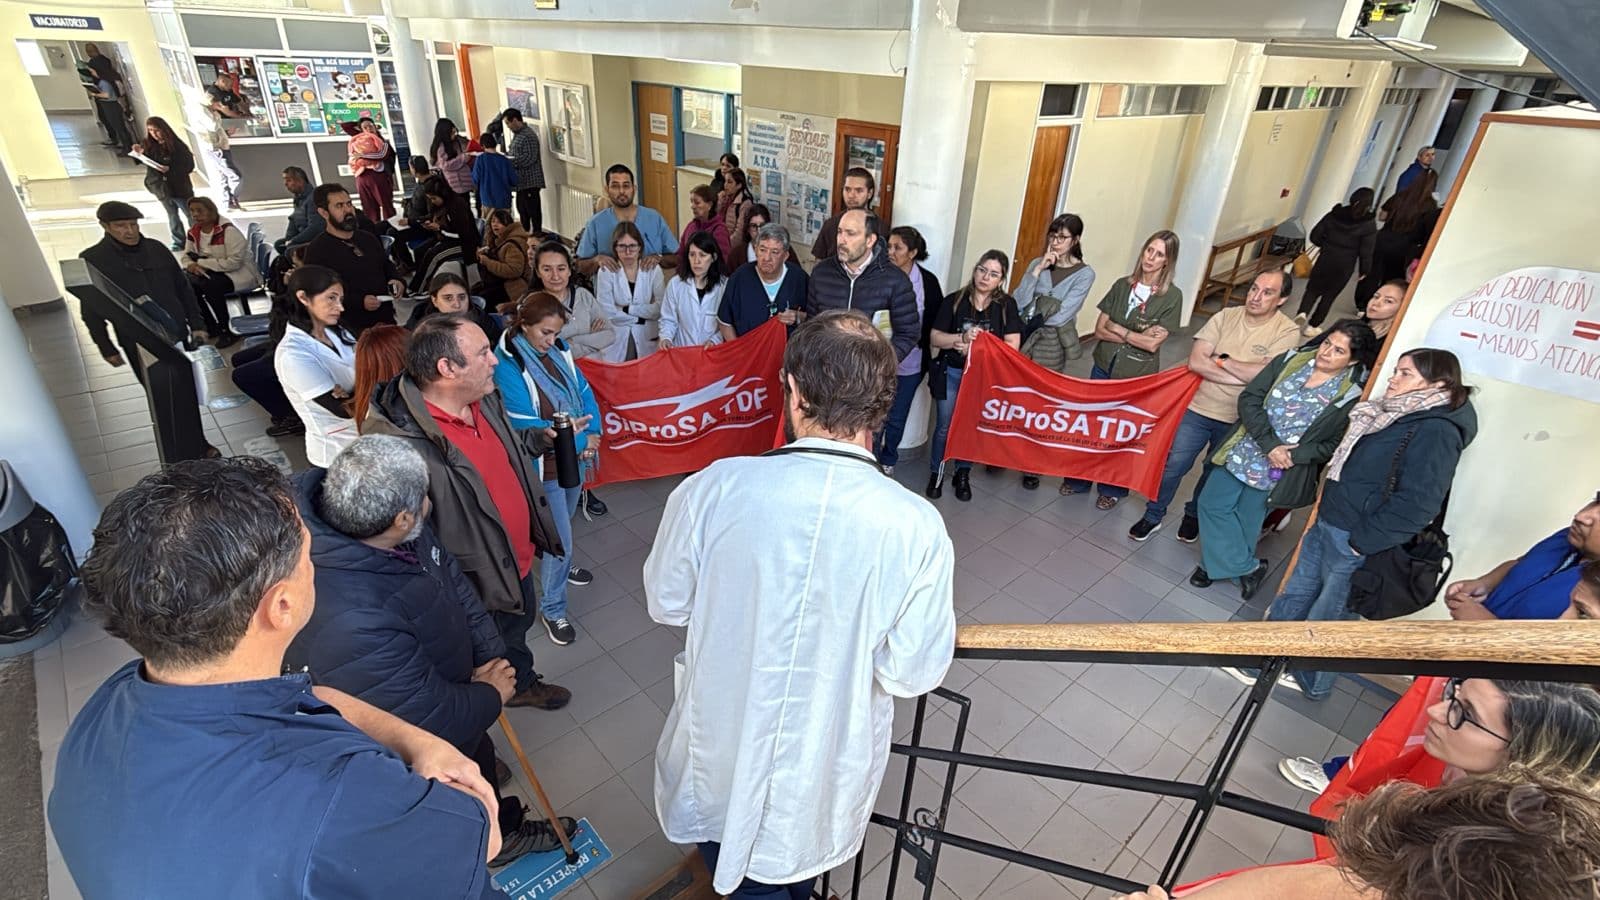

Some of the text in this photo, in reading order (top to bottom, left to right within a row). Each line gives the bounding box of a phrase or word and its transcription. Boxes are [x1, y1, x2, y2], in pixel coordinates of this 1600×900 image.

[1501, 276, 1595, 312] DEDICACIÓN
[1452, 299, 1540, 333] EXCLUSIVA
[1478, 333, 1600, 380] MENOS ATENCI
[720, 386, 768, 415] TDF
[981, 399, 1157, 442] SiProSA TDF
[527, 884, 545, 899] LA
